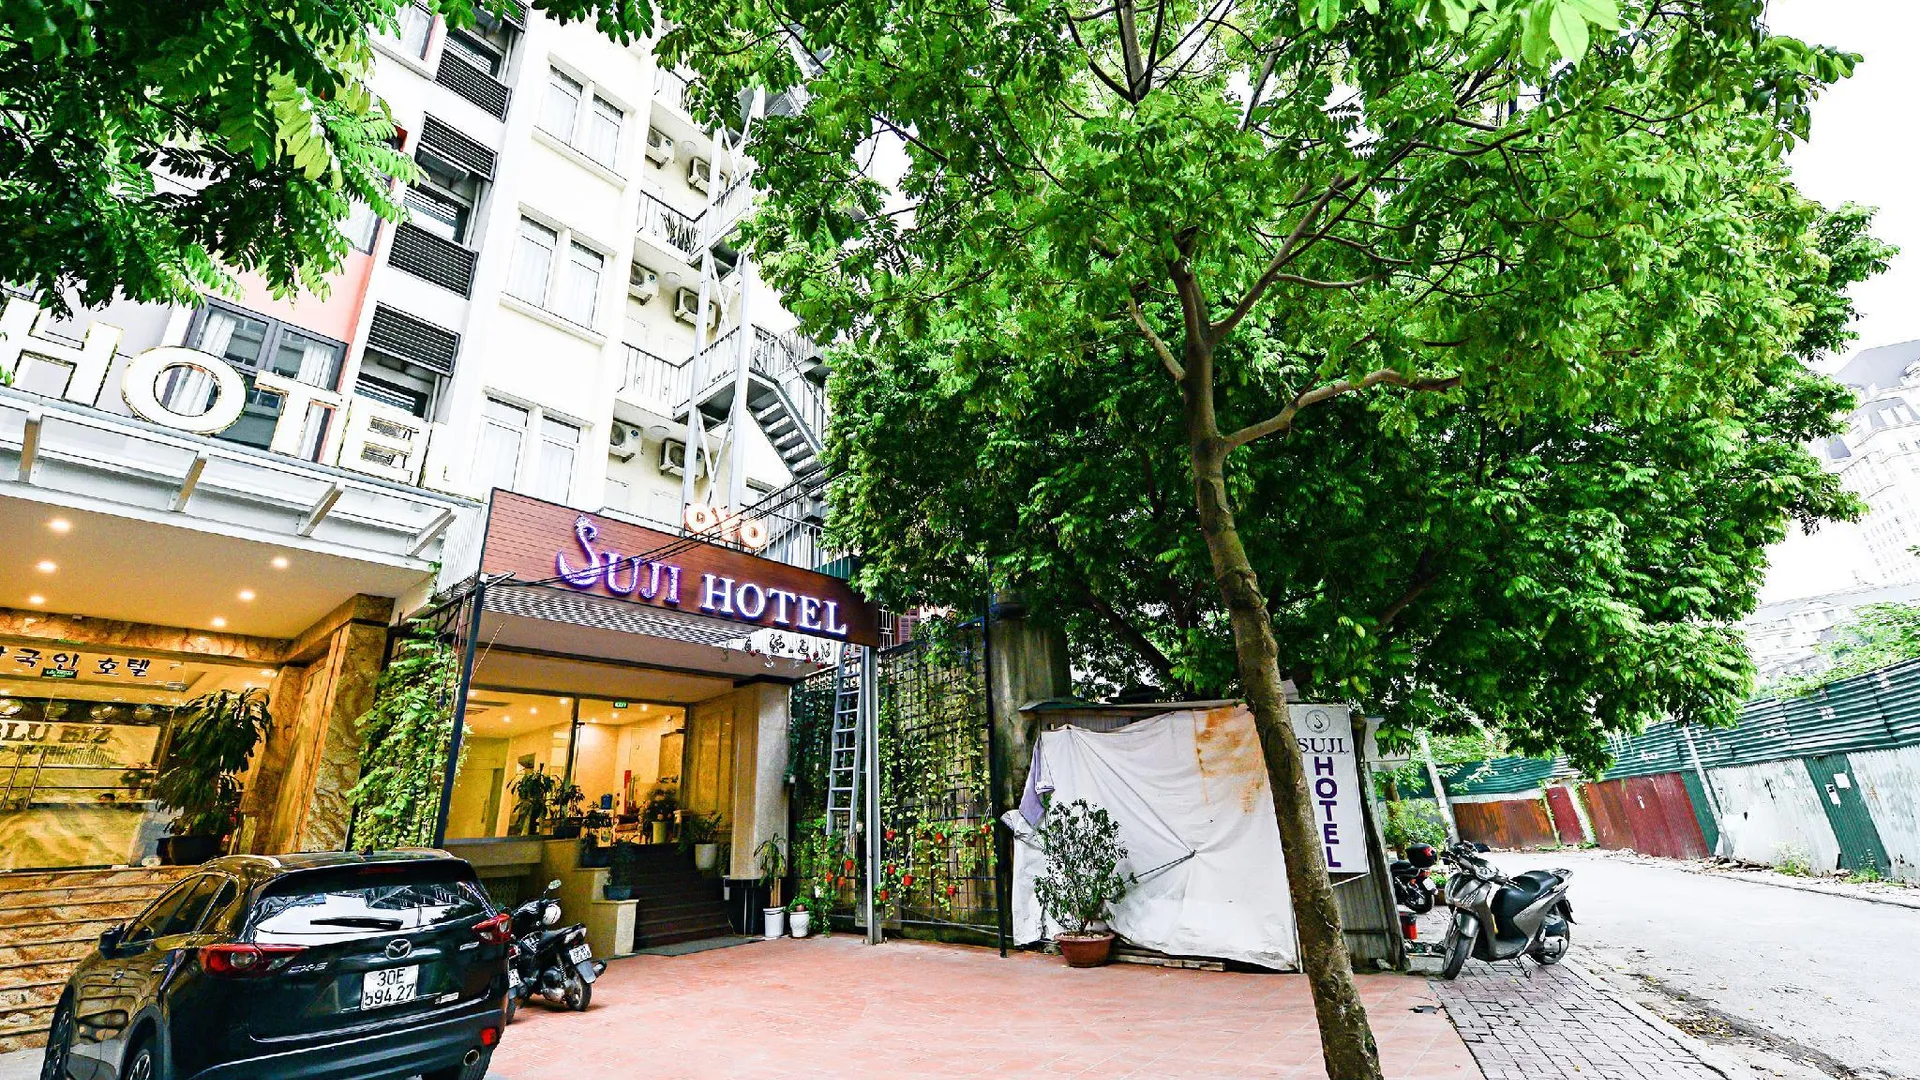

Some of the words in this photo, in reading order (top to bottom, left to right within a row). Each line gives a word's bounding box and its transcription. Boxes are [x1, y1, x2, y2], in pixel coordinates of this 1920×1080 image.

[555, 513, 681, 605] SUJI
[701, 572, 847, 636] HOTEL
[0, 645, 80, 672] 국인
[1314, 756, 1341, 868] HOTEL
[377, 968, 406, 987] 30E
[364, 983, 415, 1006] 594.27
